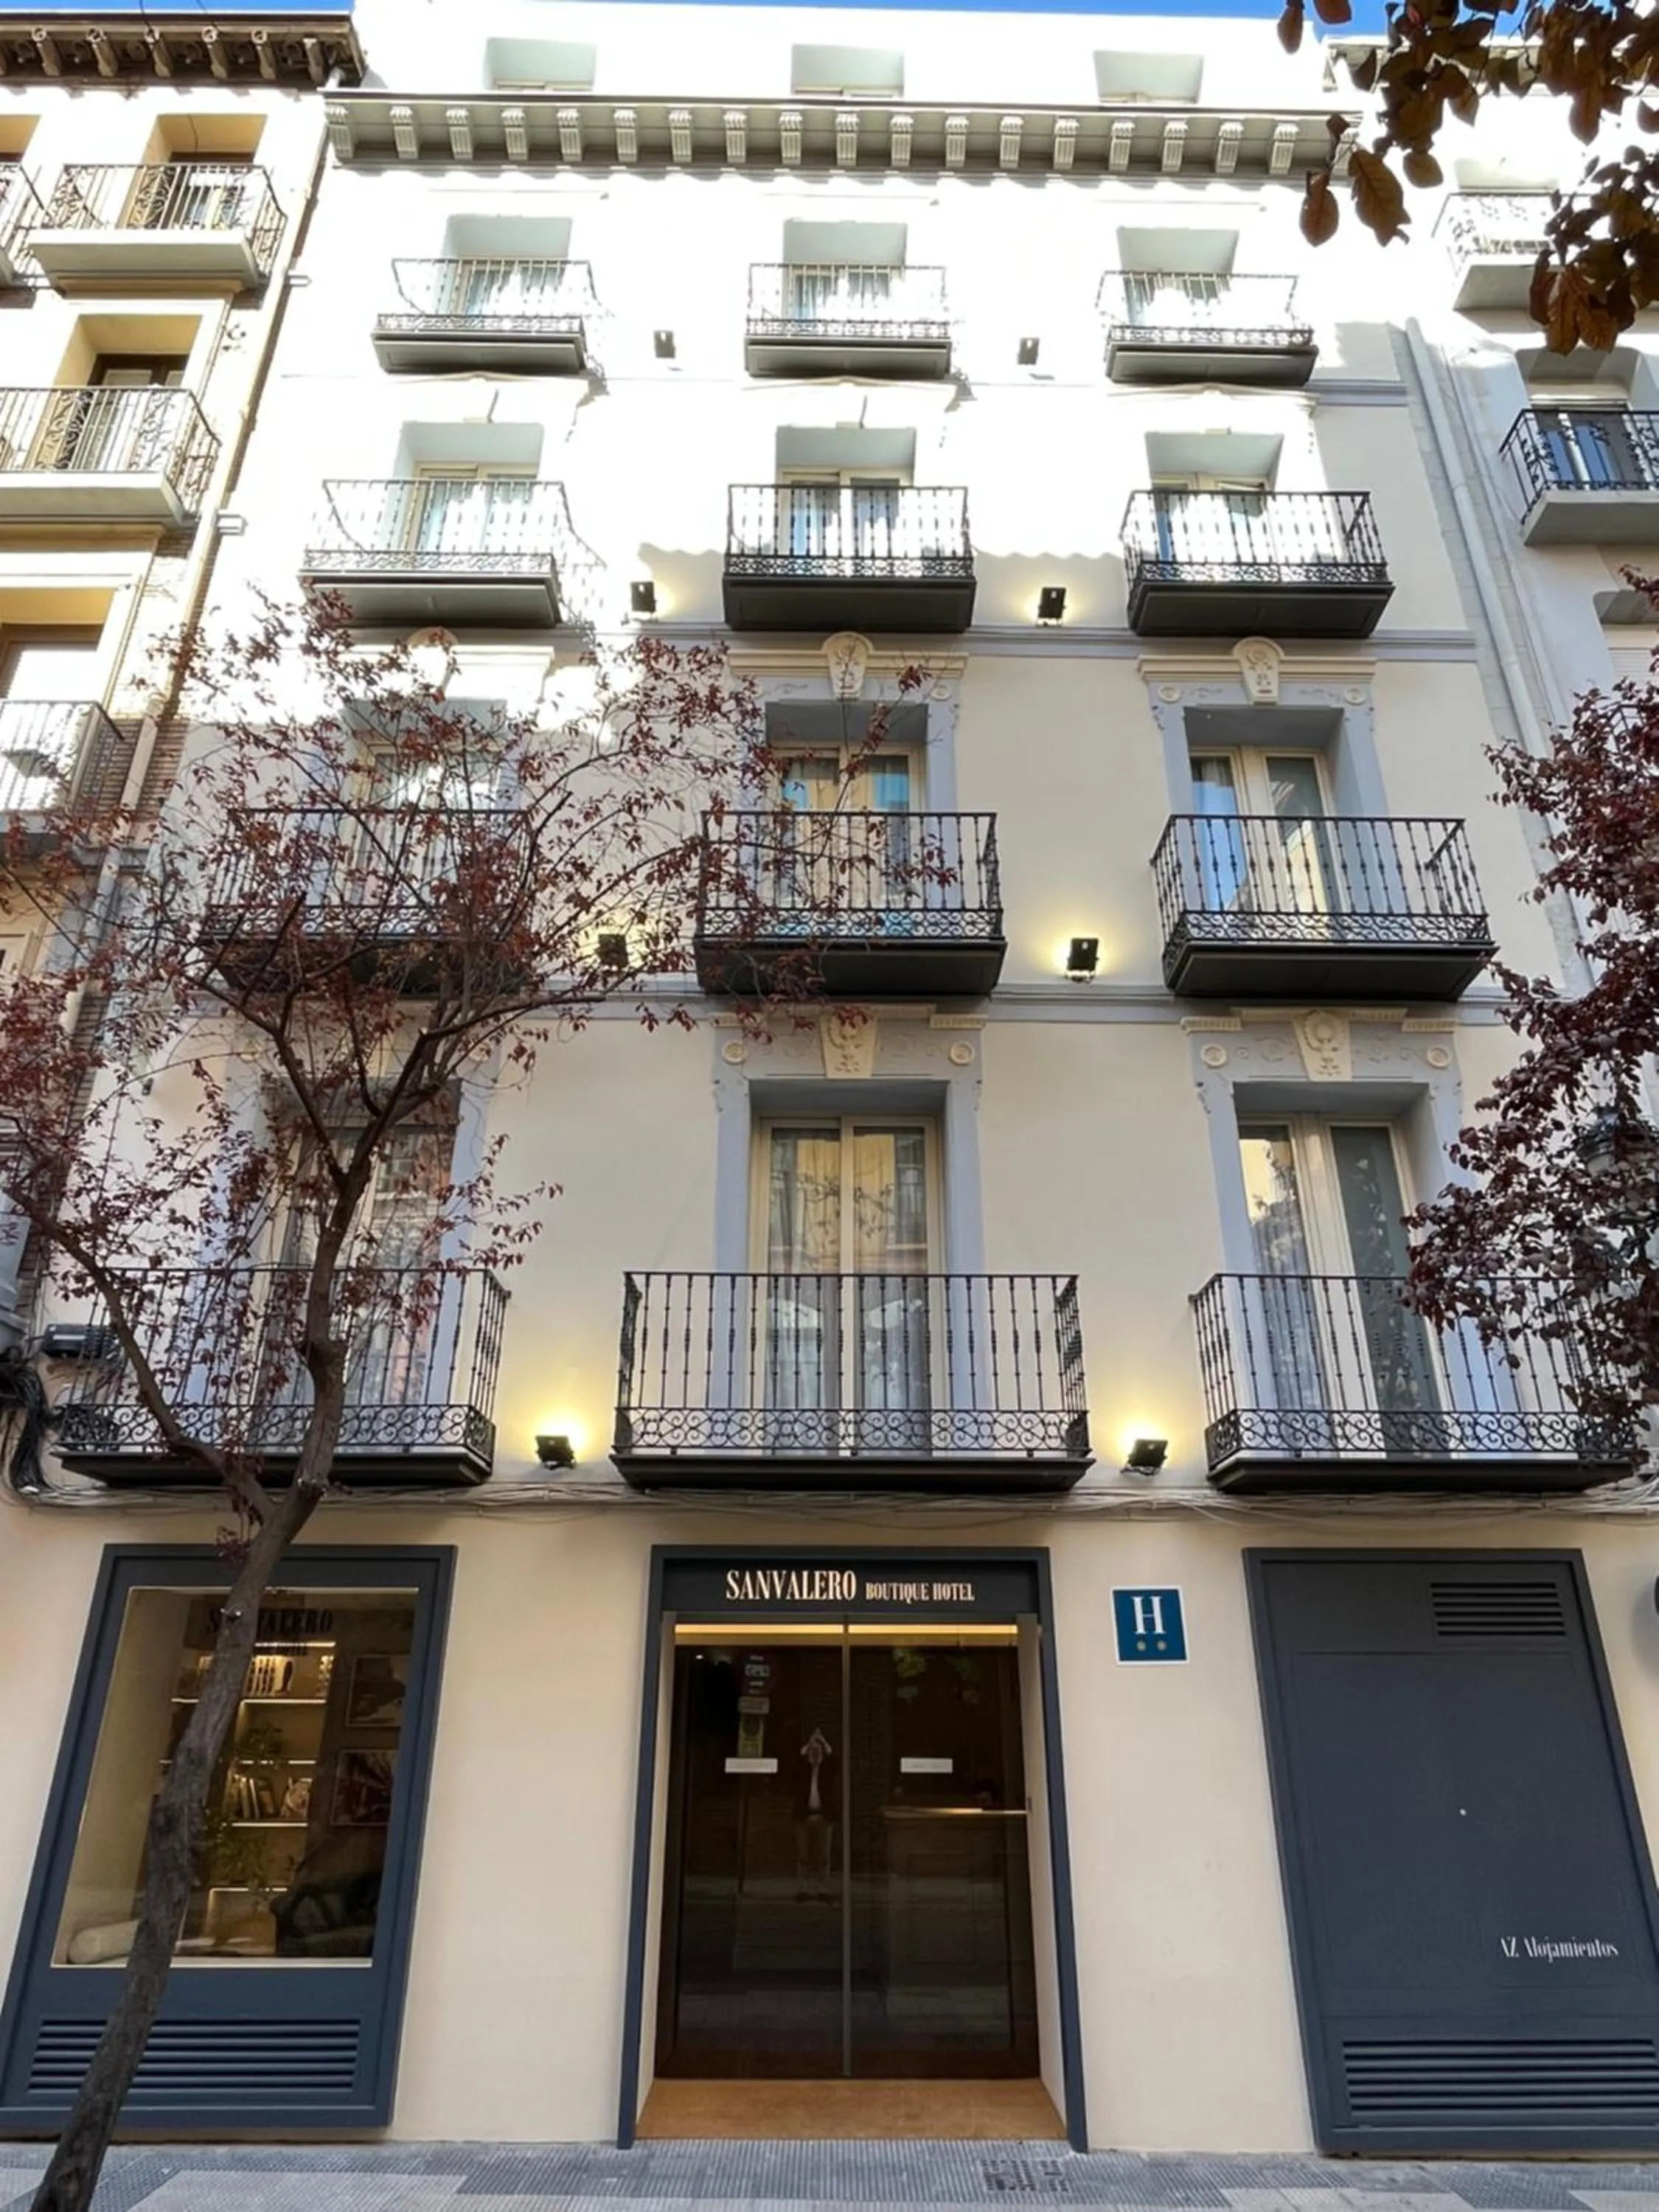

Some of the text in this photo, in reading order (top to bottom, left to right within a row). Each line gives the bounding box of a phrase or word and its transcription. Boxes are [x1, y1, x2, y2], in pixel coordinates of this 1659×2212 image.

[726, 1570, 975, 1604] SANVALERO BOUTIQUE HOTEL
[1131, 1596, 1167, 1635] H
[1524, 1935, 1619, 1964] Alojamientos
